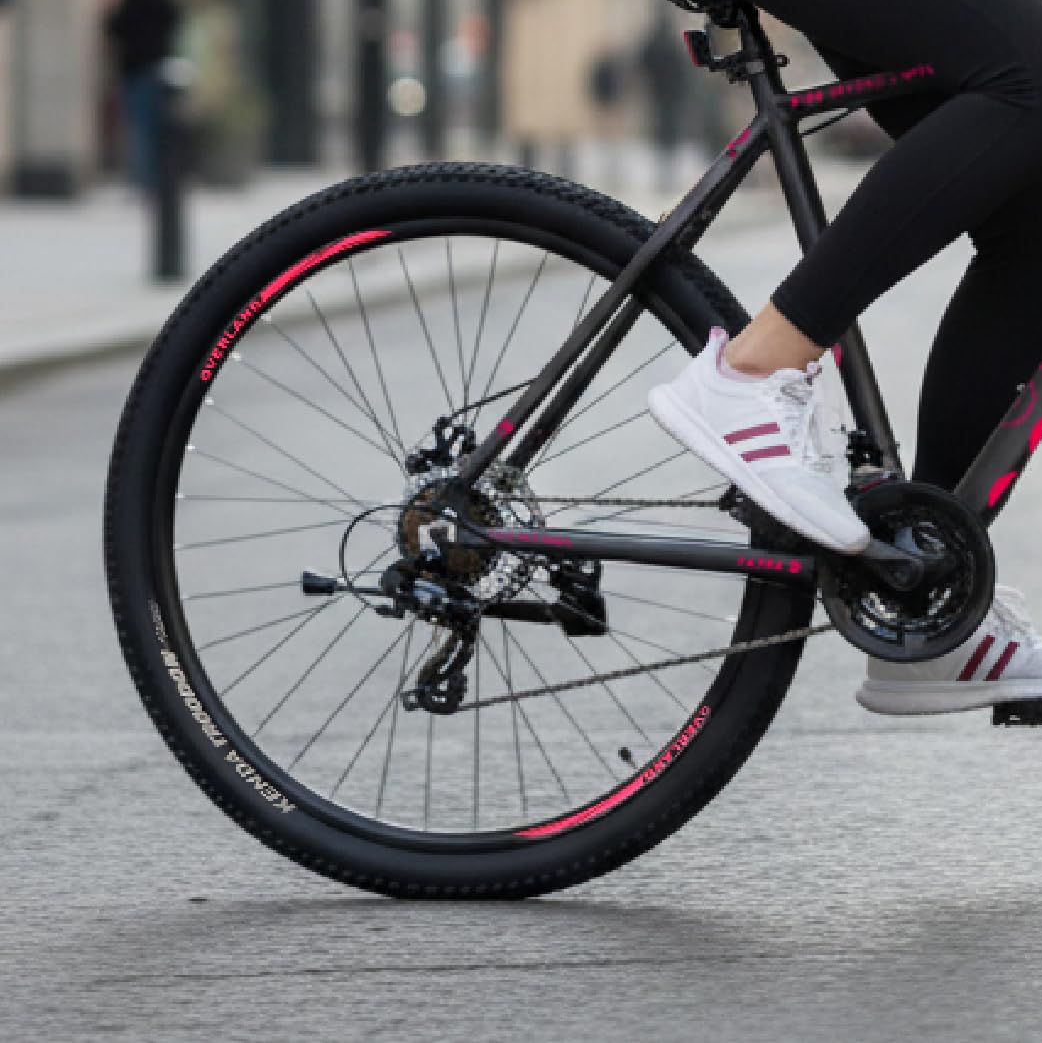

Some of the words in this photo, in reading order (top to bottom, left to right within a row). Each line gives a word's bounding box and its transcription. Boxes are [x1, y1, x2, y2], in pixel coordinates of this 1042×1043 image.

[200, 300, 263, 382] OVERLAND
[223, 749, 297, 815] KENDA
[643, 704, 712, 783] OVERLAND
